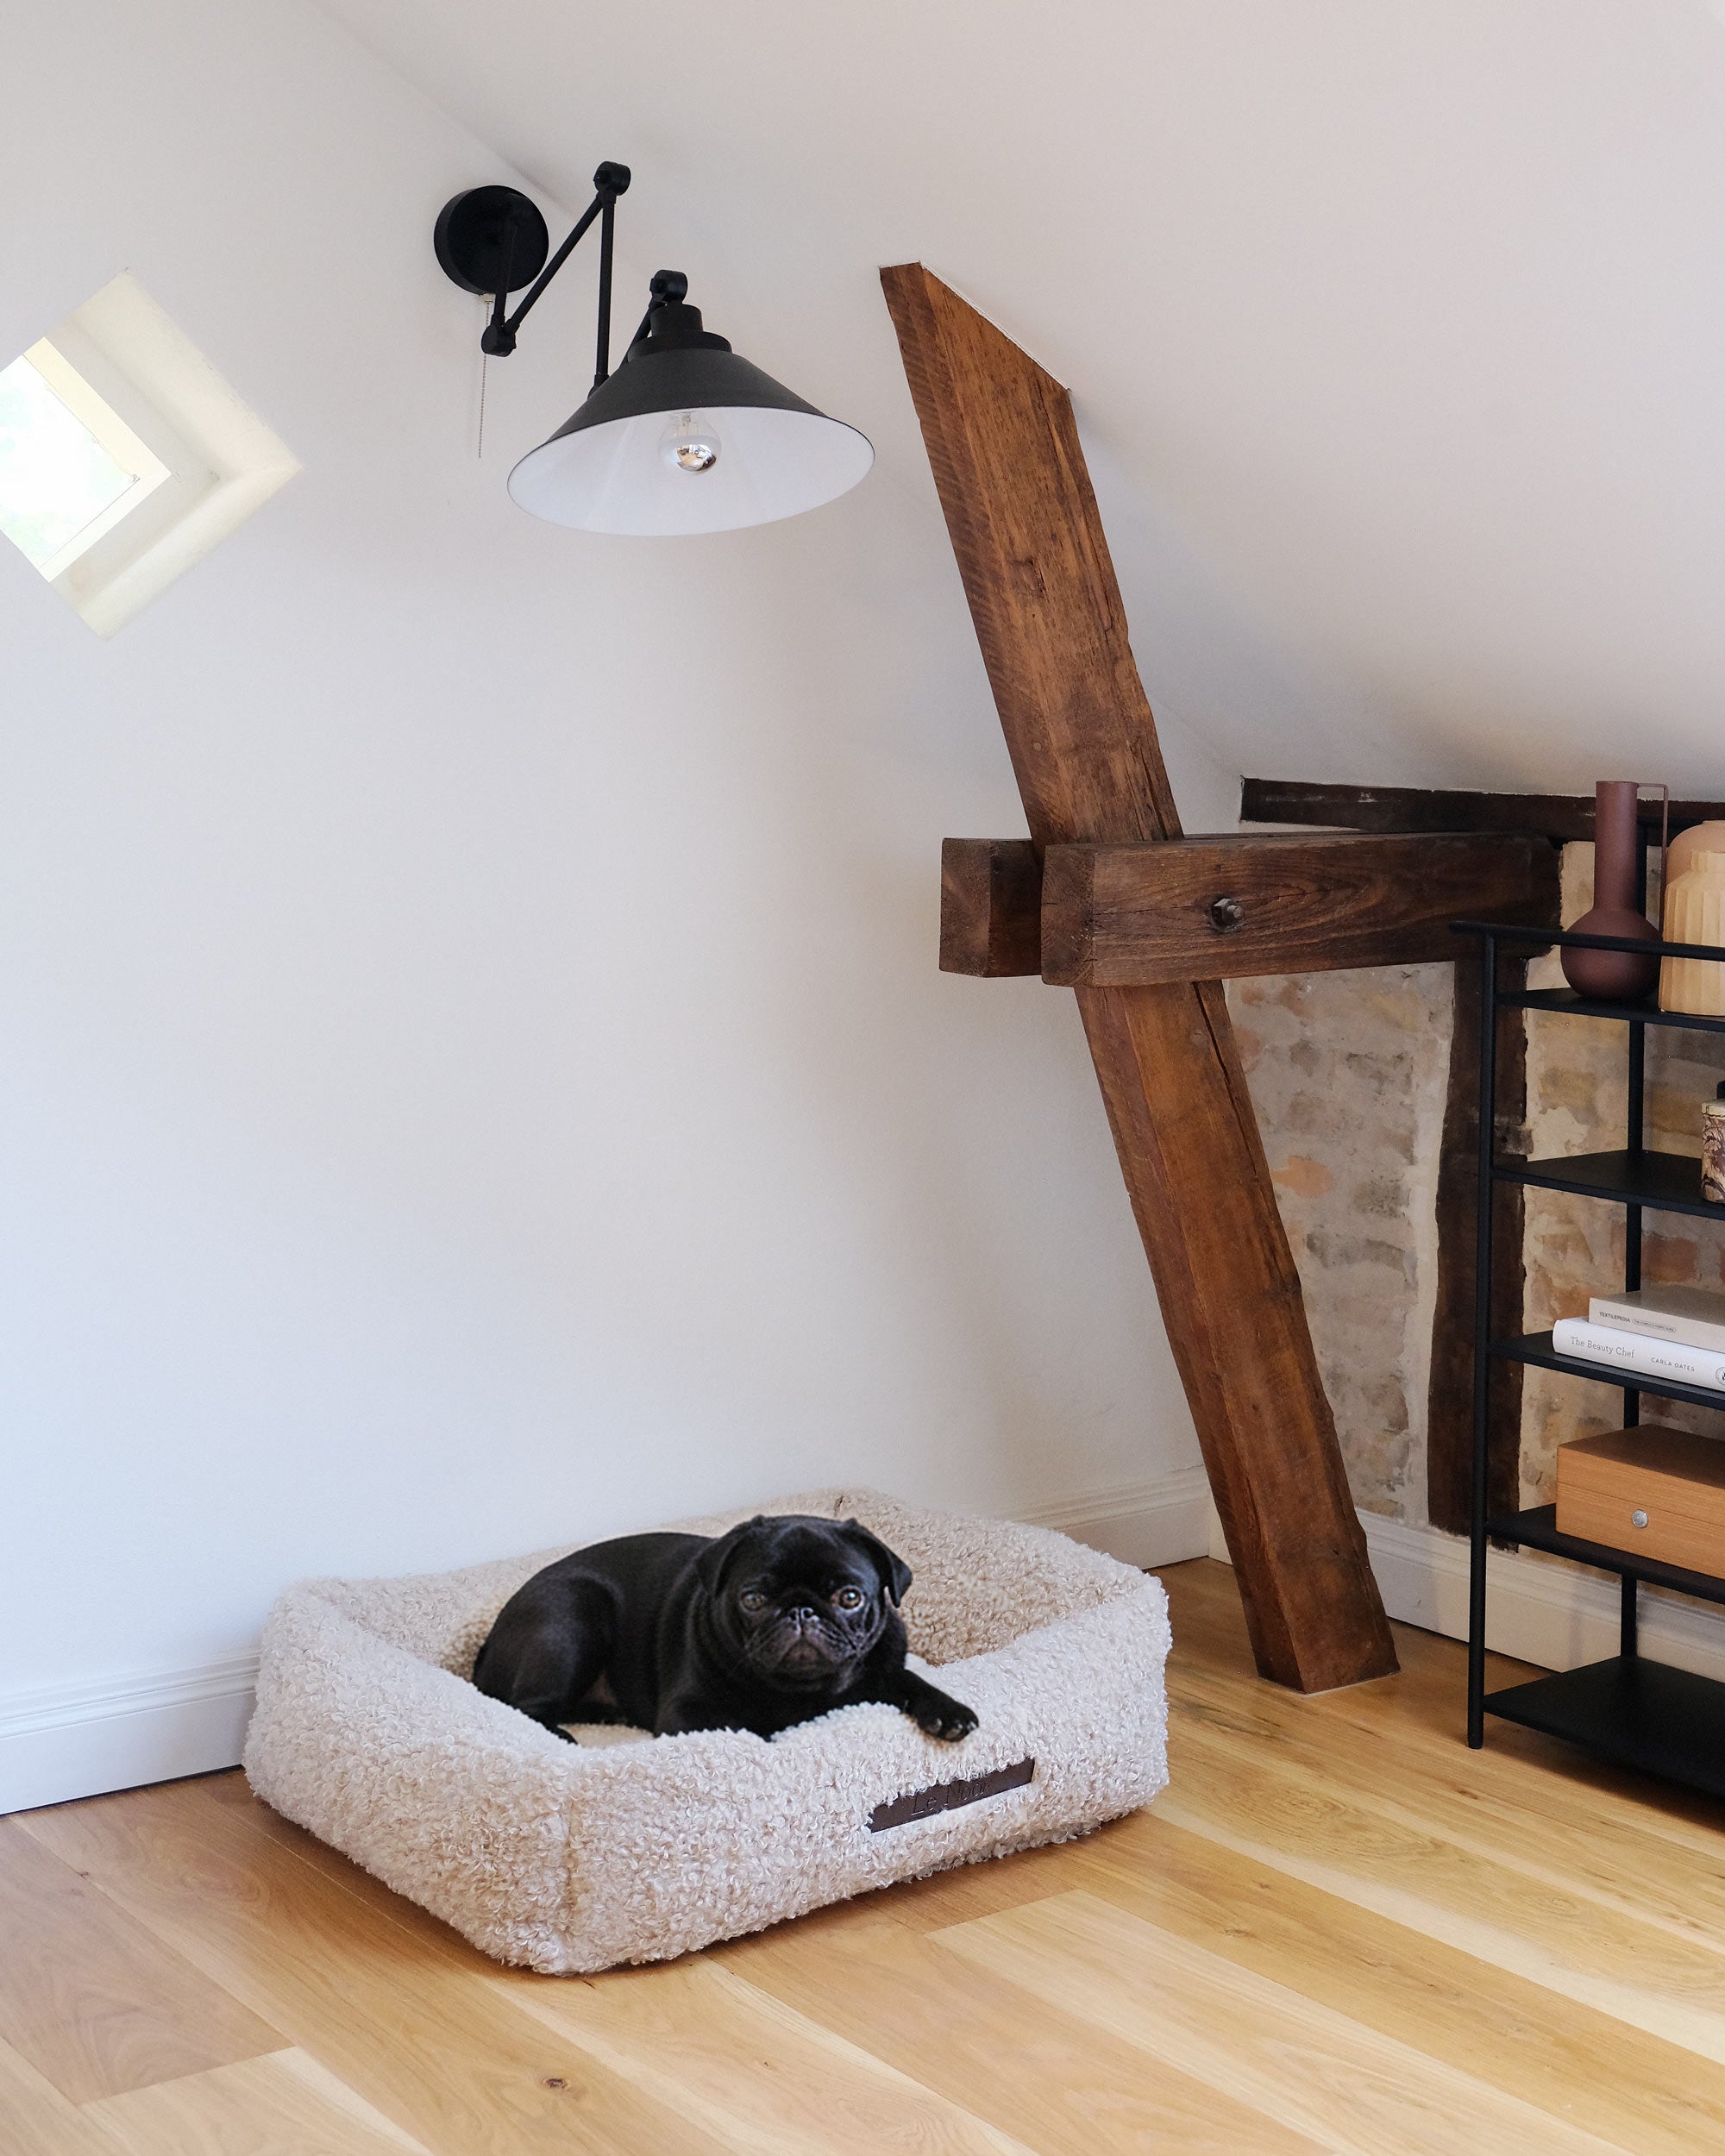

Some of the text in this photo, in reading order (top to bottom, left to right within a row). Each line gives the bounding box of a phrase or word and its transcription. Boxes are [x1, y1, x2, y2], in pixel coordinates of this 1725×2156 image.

[1599, 1312, 1630, 1322] TEXTILEPEDIA
[1570, 1336, 1634, 1358] The Beauty Chef
[1651, 1357, 1695, 1372] CARLA OATES
[912, 1791, 937, 1815] Le
